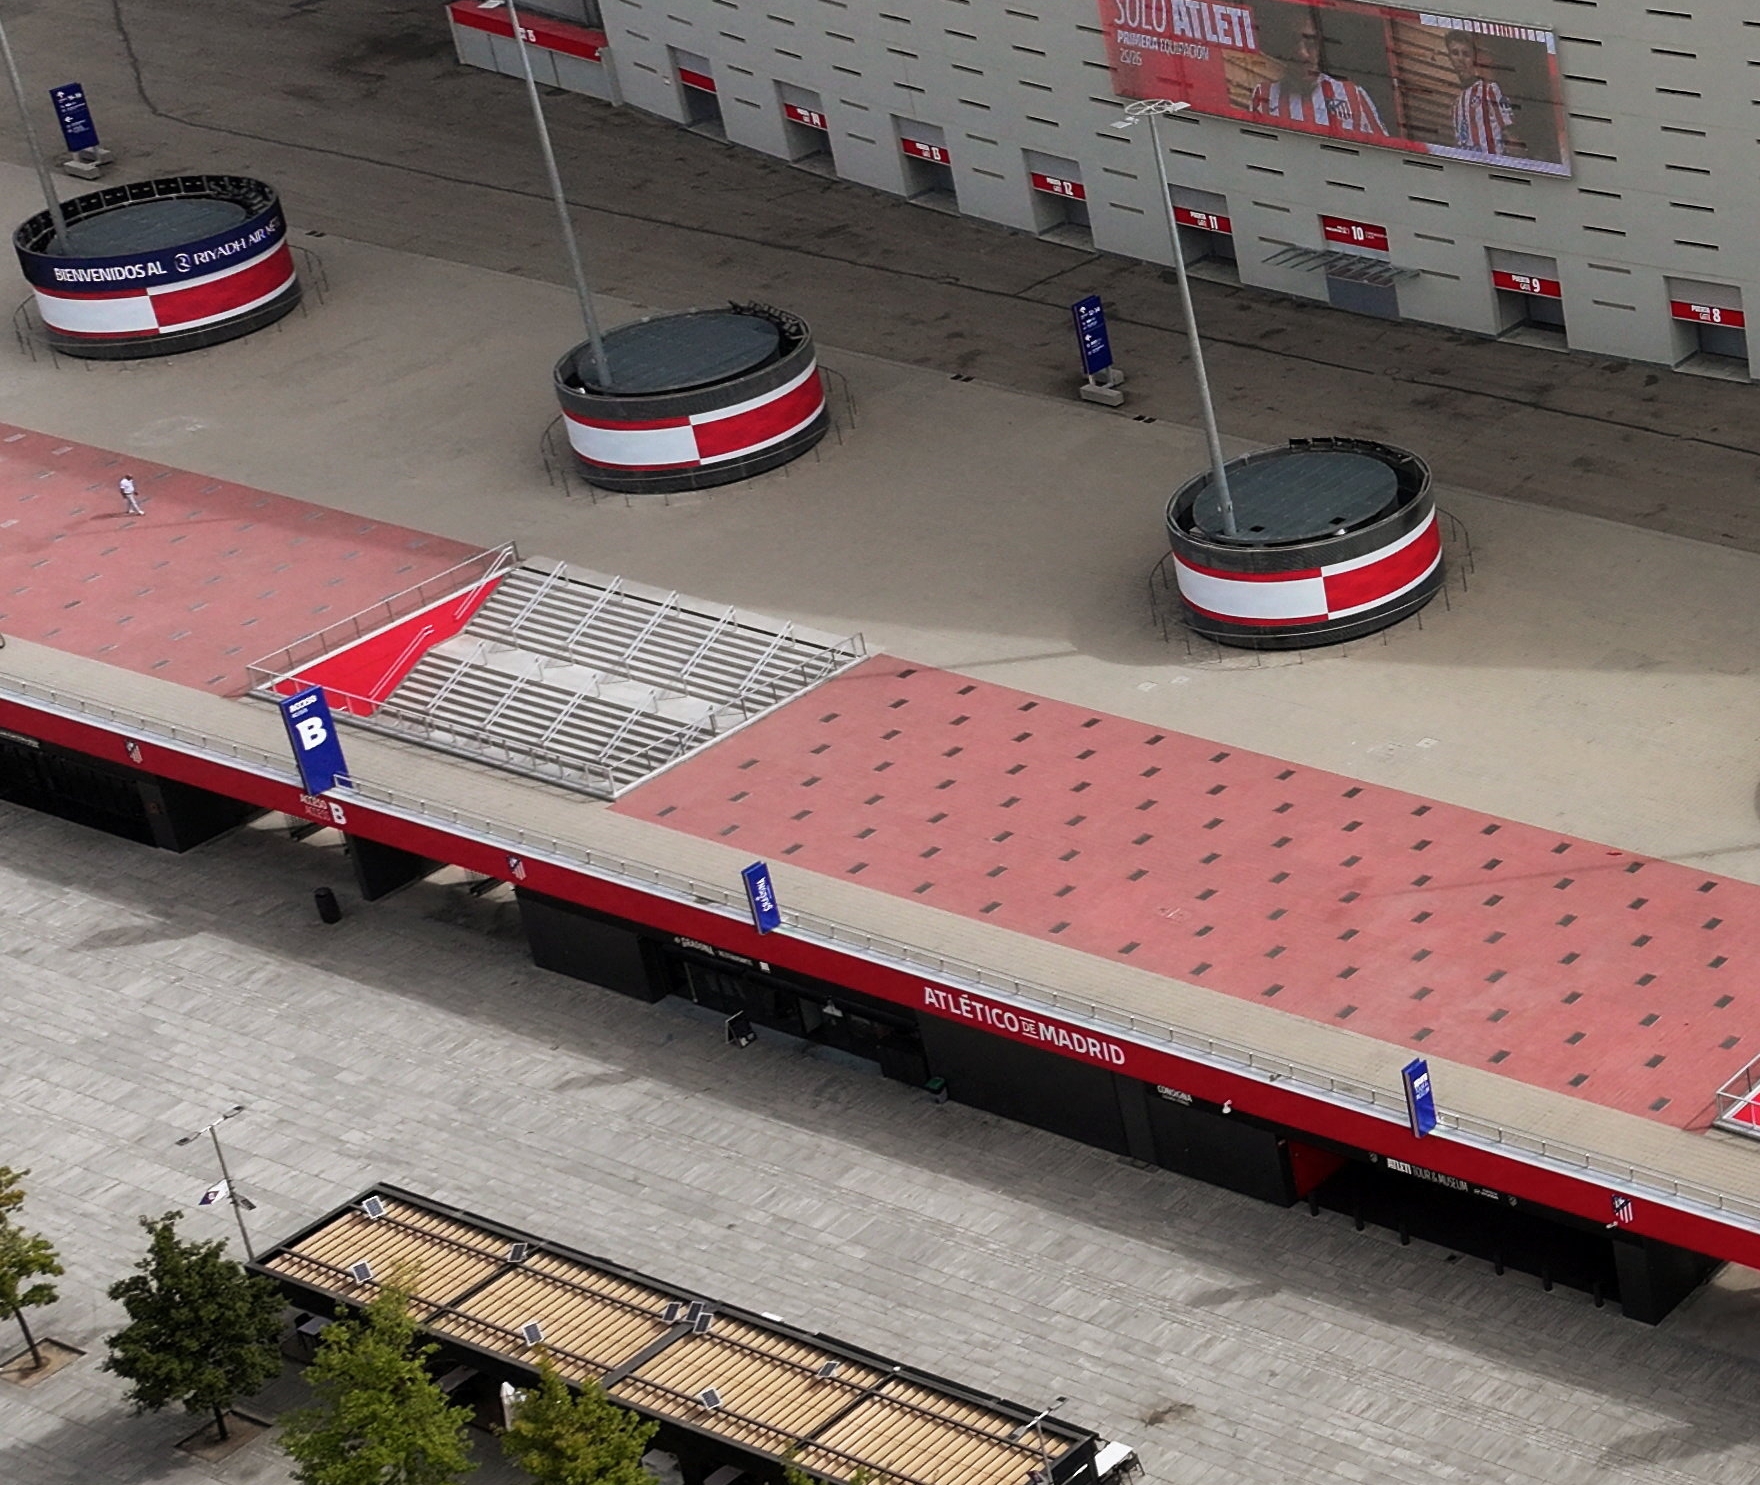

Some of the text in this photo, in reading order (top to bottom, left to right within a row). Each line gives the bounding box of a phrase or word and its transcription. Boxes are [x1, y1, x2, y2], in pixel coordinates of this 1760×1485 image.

[1351, 226, 1364, 240] 10
[54, 262, 147, 282] BIENVENIDOS
[147, 261, 167, 276] AL
[194, 238, 246, 266] RIYADH
[1532, 278, 1540, 293] 9
[1712, 308, 1721, 323] 8
[295, 716, 327, 751] B
[328, 802, 347, 825] B
[924, 986, 1126, 1065] ATLÉTICO DE MADRID
